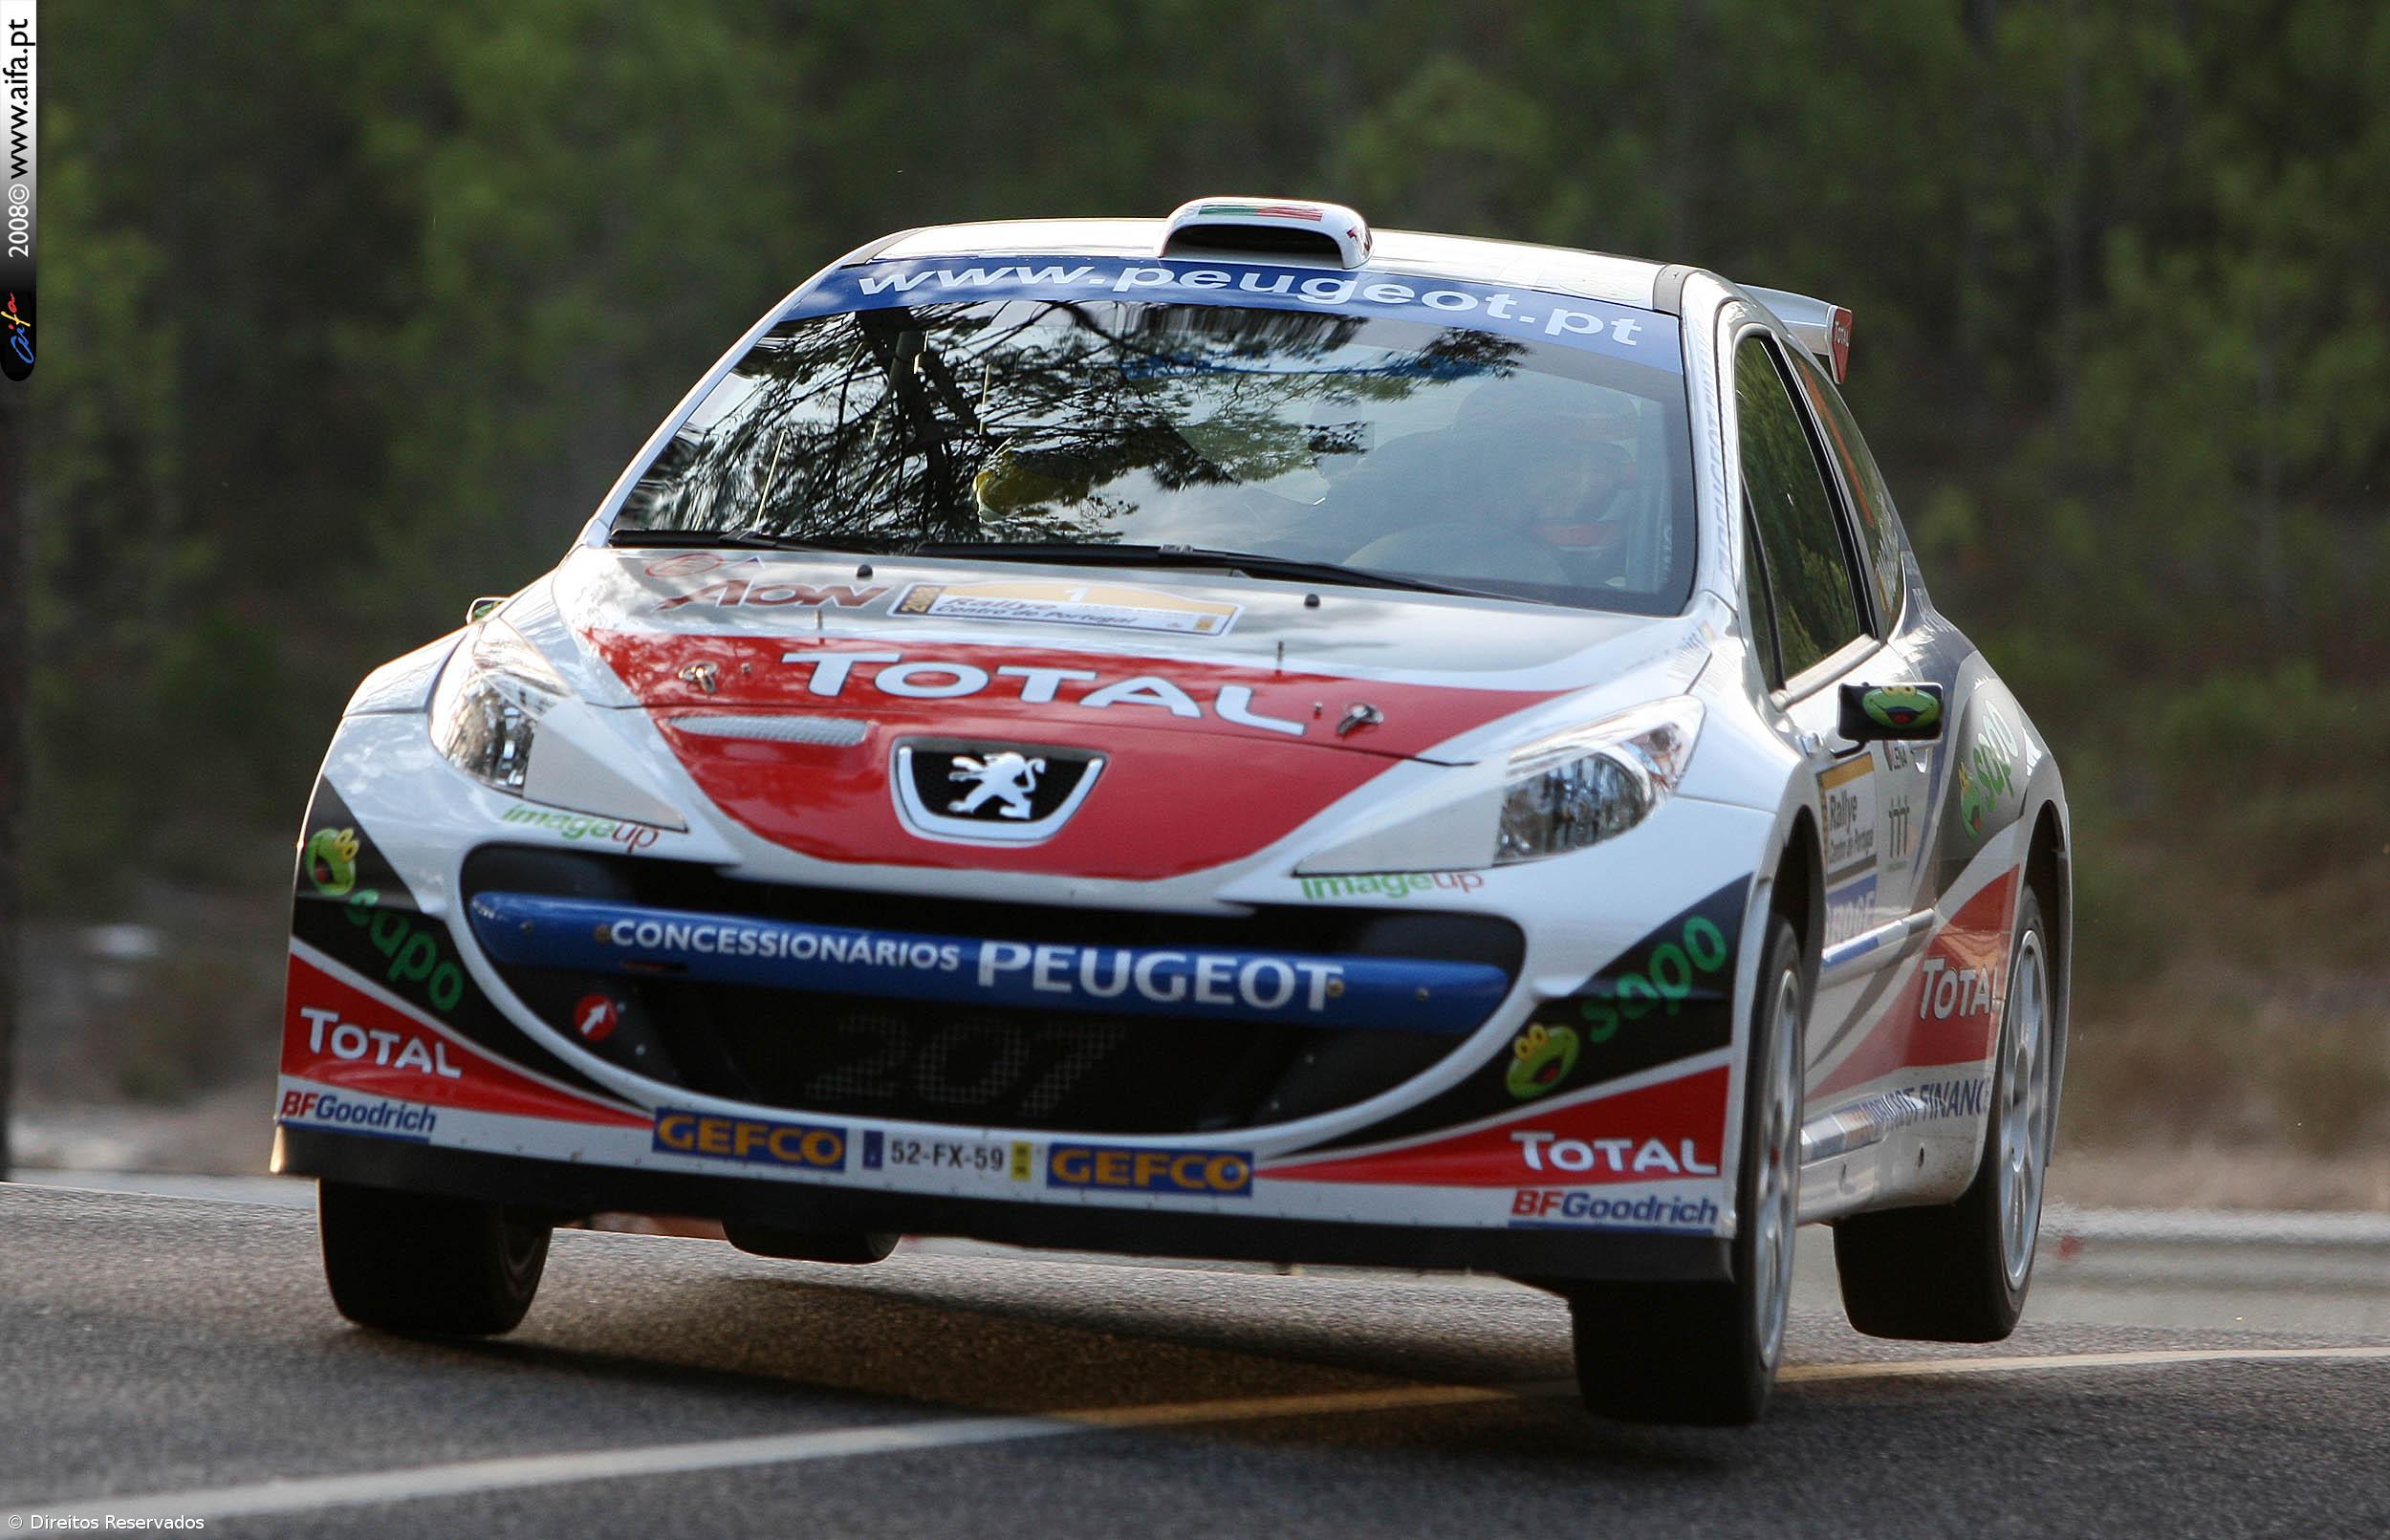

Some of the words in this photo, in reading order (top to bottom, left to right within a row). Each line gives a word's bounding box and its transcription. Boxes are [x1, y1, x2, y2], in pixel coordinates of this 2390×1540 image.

[857, 263, 1643, 346] www.peugeot.pt
[780, 651, 1307, 736] TOTAL
[501, 804, 661, 854] imageup
[1829, 790, 1858, 833] Rallye
[1301, 871, 1485, 900] imageup
[346, 888, 464, 1010] sapo
[609, 918, 961, 972] CONCESSIONÁRIOS
[977, 940, 1344, 1011] PEUGEOT
[1580, 914, 1727, 1044] sapo
[299, 1006, 463, 1080] TOTAL
[804, 1013, 1127, 1118] 207
[280, 1089, 438, 1134] BFGoodrich
[1919, 1078, 1988, 1121] FINANC
[657, 1115, 844, 1167] GEFCO
[890, 1139, 1005, 1173] 52-FX-59
[1510, 1130, 1719, 1177] TOTAL
[1052, 1149, 1249, 1191] GEFCO
[1510, 1189, 1719, 1225] BFGoodrich
